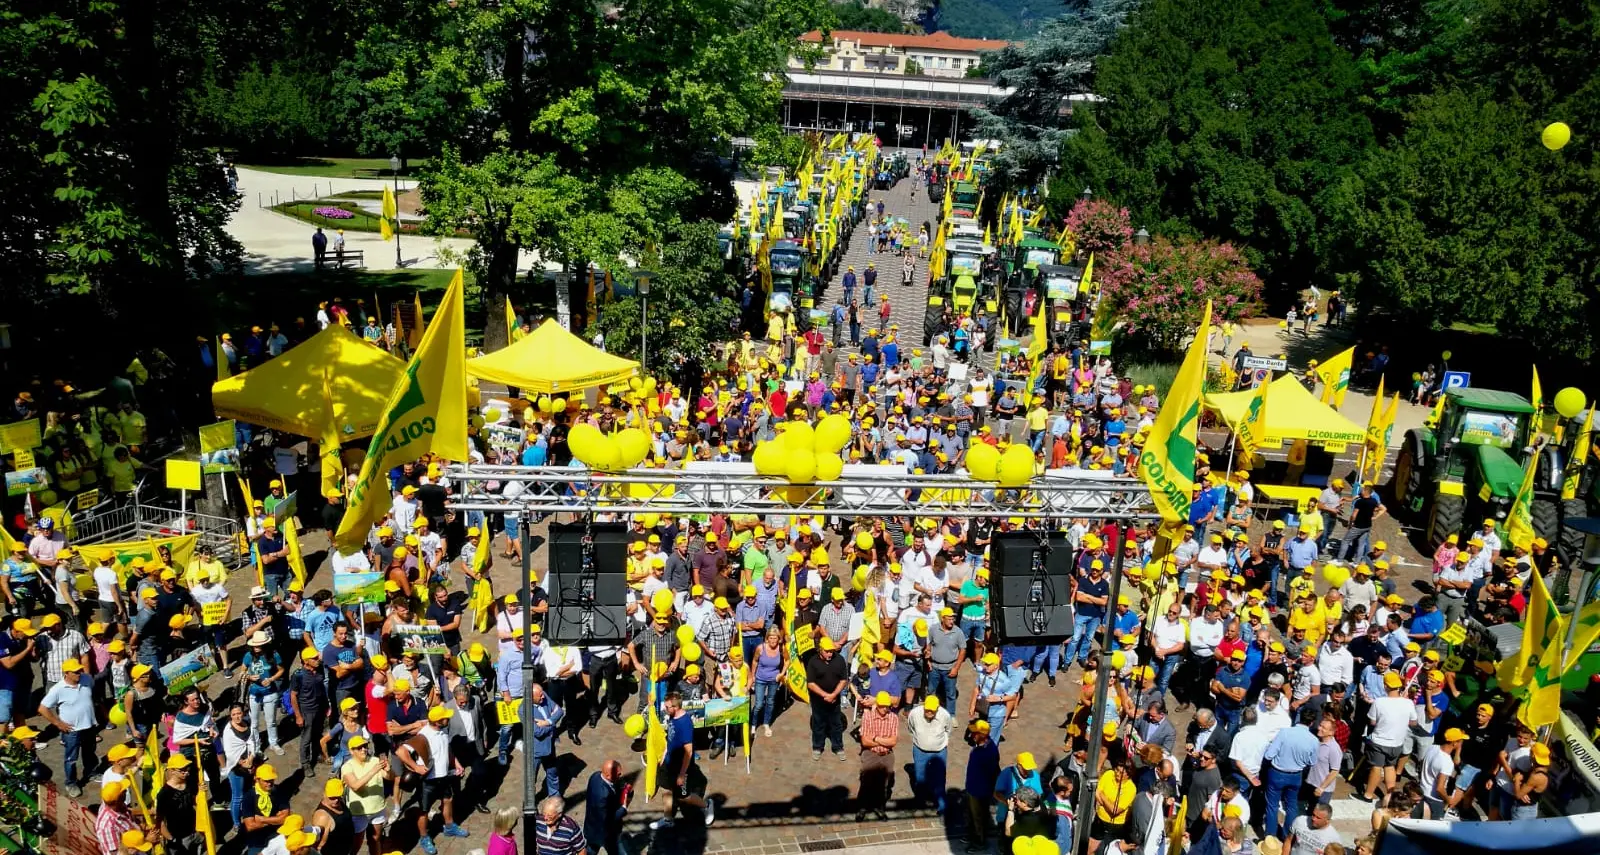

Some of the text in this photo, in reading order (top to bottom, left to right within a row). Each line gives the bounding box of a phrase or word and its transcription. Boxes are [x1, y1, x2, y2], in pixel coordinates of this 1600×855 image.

[1448, 374, 1464, 388] P
[1318, 431, 1364, 441] COLDIRETTI
[1141, 451, 1192, 521] COLDIRE
